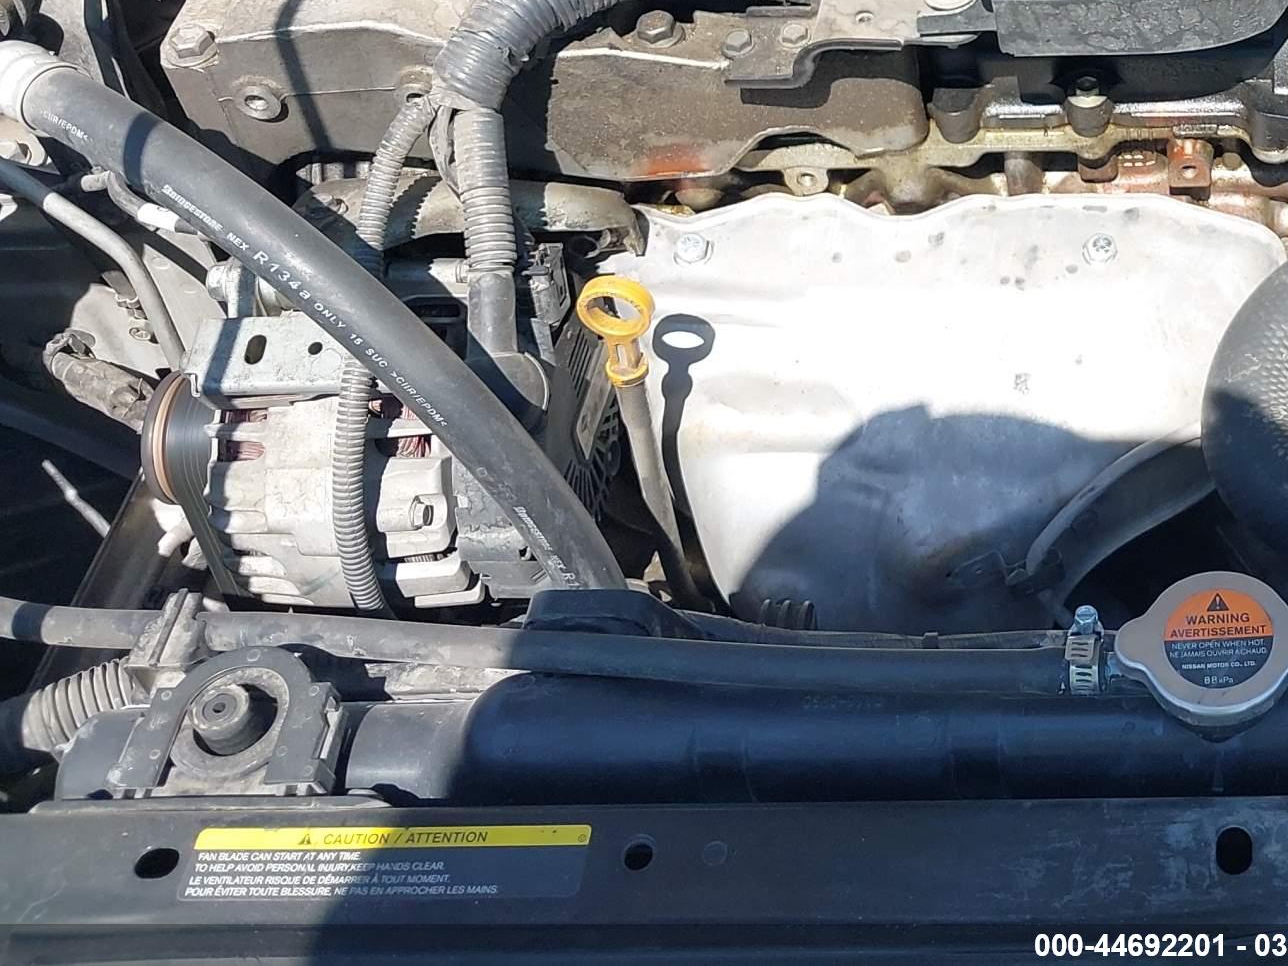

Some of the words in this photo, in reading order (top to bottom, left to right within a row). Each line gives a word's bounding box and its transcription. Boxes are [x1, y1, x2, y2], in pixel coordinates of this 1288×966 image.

[226, 232, 250, 251] NEX
[253, 250, 312, 300] R134a
[314, 302, 347, 330] ONLY
[350, 334, 363, 346] 15
[365, 347, 388, 368] SUC
[1186, 613, 1250, 625] WARNING
[1169, 625, 1267, 638] AVERTISSEMENT
[1171, 641, 1197, 650] NEVER
[1198, 640, 1221, 649] OPEN
[1222, 640, 1247, 648] WHEN
[323, 833, 390, 846] CAUTION
[404, 831, 489, 844] ATTENTION
[198, 852, 218, 862] FAN
[219, 852, 249, 862] BLADE
[250, 852, 272, 862] CAN
[274, 852, 302, 862] START
[303, 852, 315, 862] AT
[317, 851, 338, 861] ANY
[195, 863, 208, 872] TO
[209, 863, 234, 872] HELP
[234, 863, 265, 872] AVOID
[265, 863, 316, 872] PERSONAL
[376, 862, 410, 871] HANDS
[188, 876, 202, 886] LE
[202, 876, 264, 885] VENTILATEUR
[264, 876, 301, 885] RISQUE
[302, 876, 317, 885] DE
[317, 873, 371, 885] DÉMARRER
[381, 875, 406, 884] TOUT
[184, 887, 214, 897] POUR
[214, 885, 247, 896] ÉVITER
[248, 887, 279, 896] TOUTE
[334, 887, 348, 896] NE
[349, 887, 368, 896] PAS
[369, 887, 384, 895] EN
[384, 886, 446, 895] APPROCHER
[446, 885, 466, 894] LES
